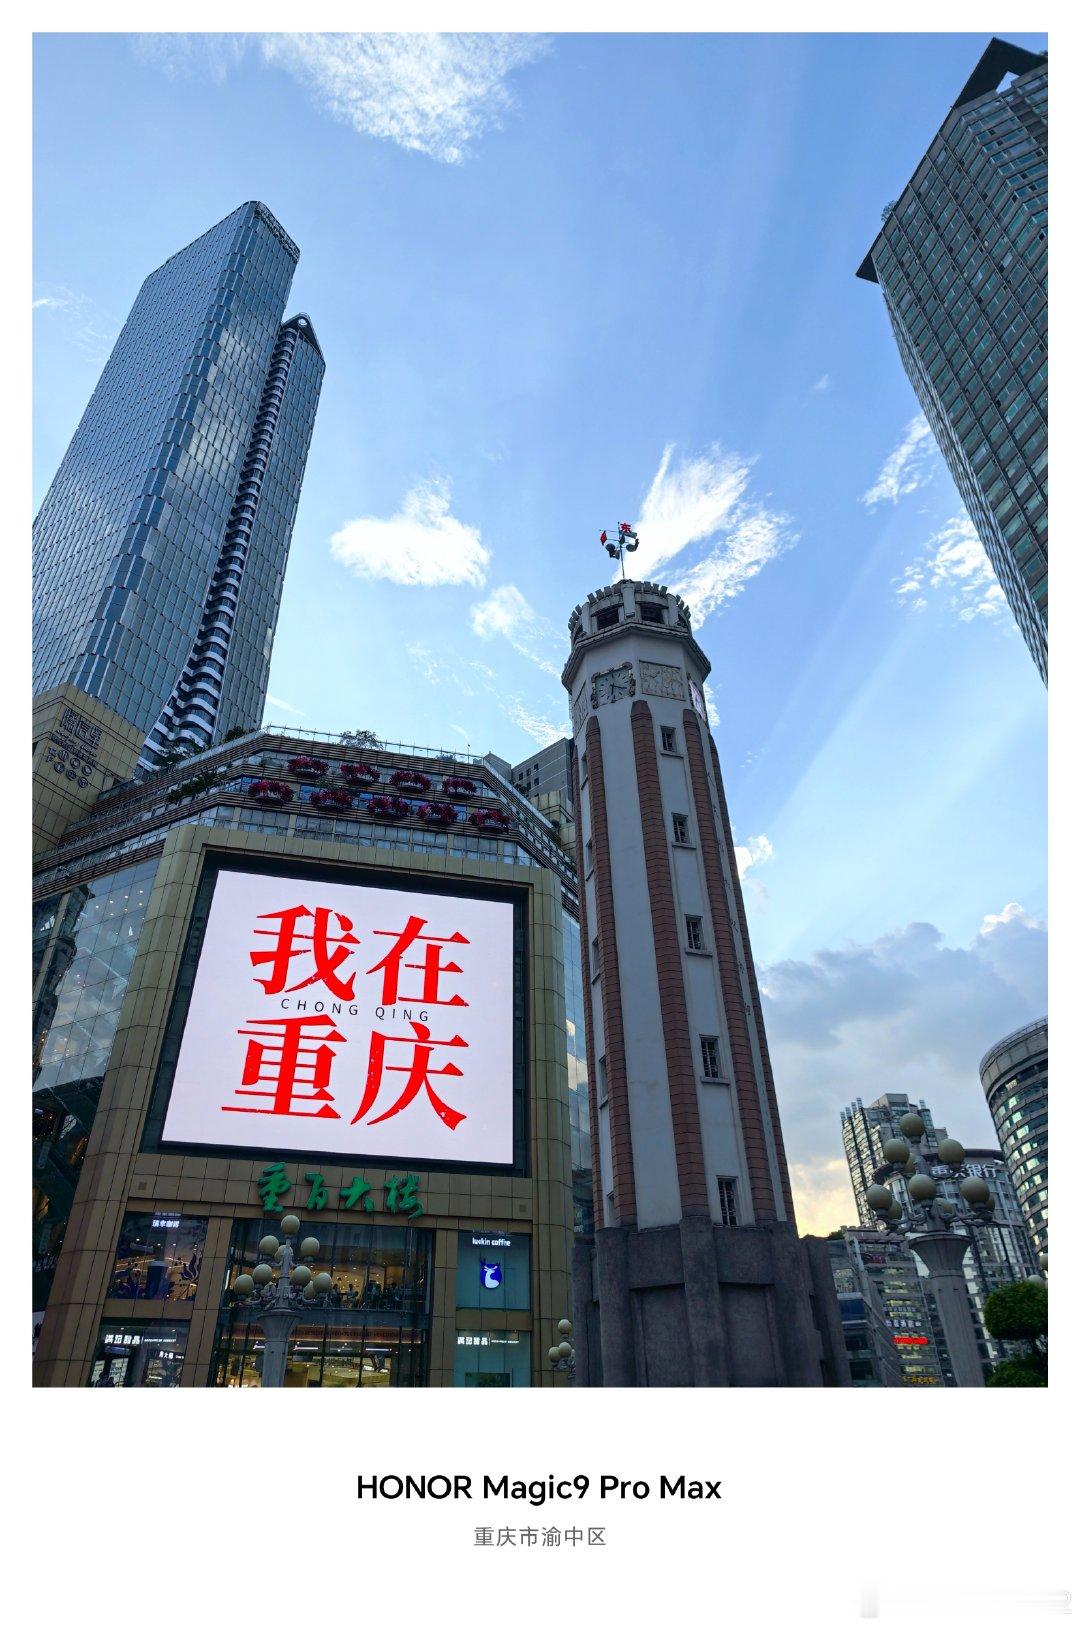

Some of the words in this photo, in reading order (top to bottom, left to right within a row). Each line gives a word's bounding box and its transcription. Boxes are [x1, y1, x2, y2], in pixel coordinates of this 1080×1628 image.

[250, 904, 470, 1007] 我在
[281, 998, 358, 1016] CHONG
[375, 1006, 429, 1022] QING
[221, 1014, 470, 1131] 重庆
